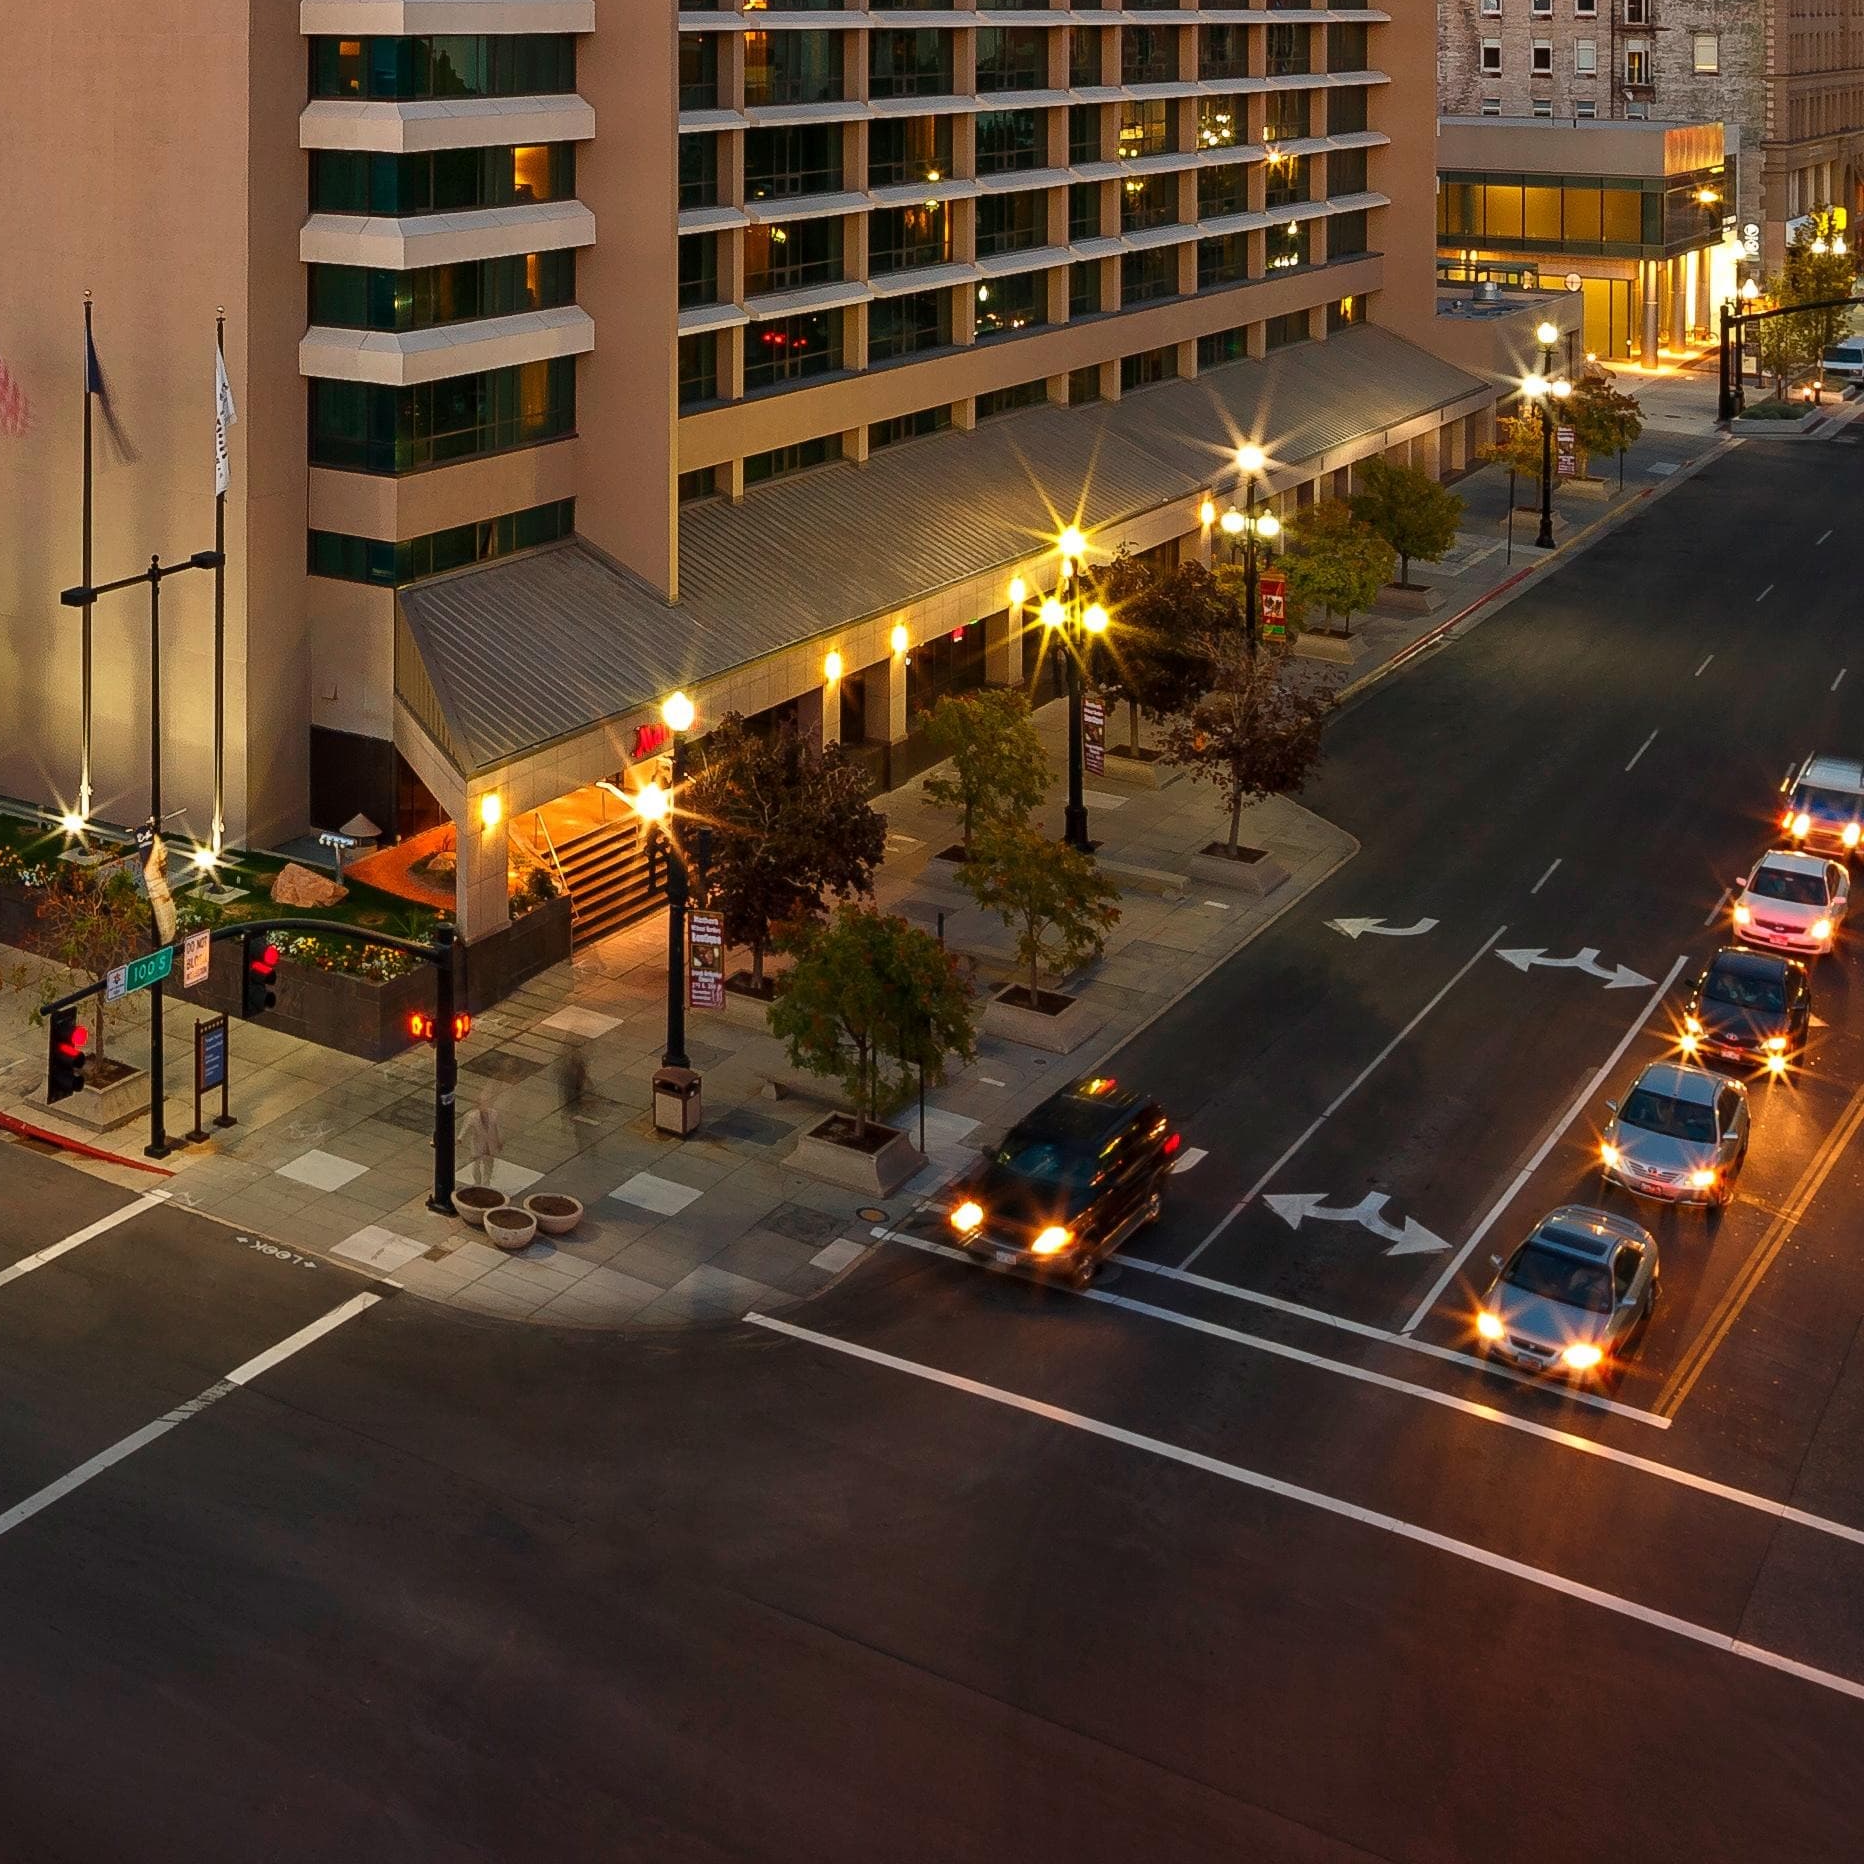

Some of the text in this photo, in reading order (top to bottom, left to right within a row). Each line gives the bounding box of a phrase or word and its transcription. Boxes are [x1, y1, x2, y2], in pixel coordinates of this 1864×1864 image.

[186, 936, 209, 955] DO NOT
[134, 955, 167, 983] 100 S
[249, 1240, 304, 1265] LOOK
